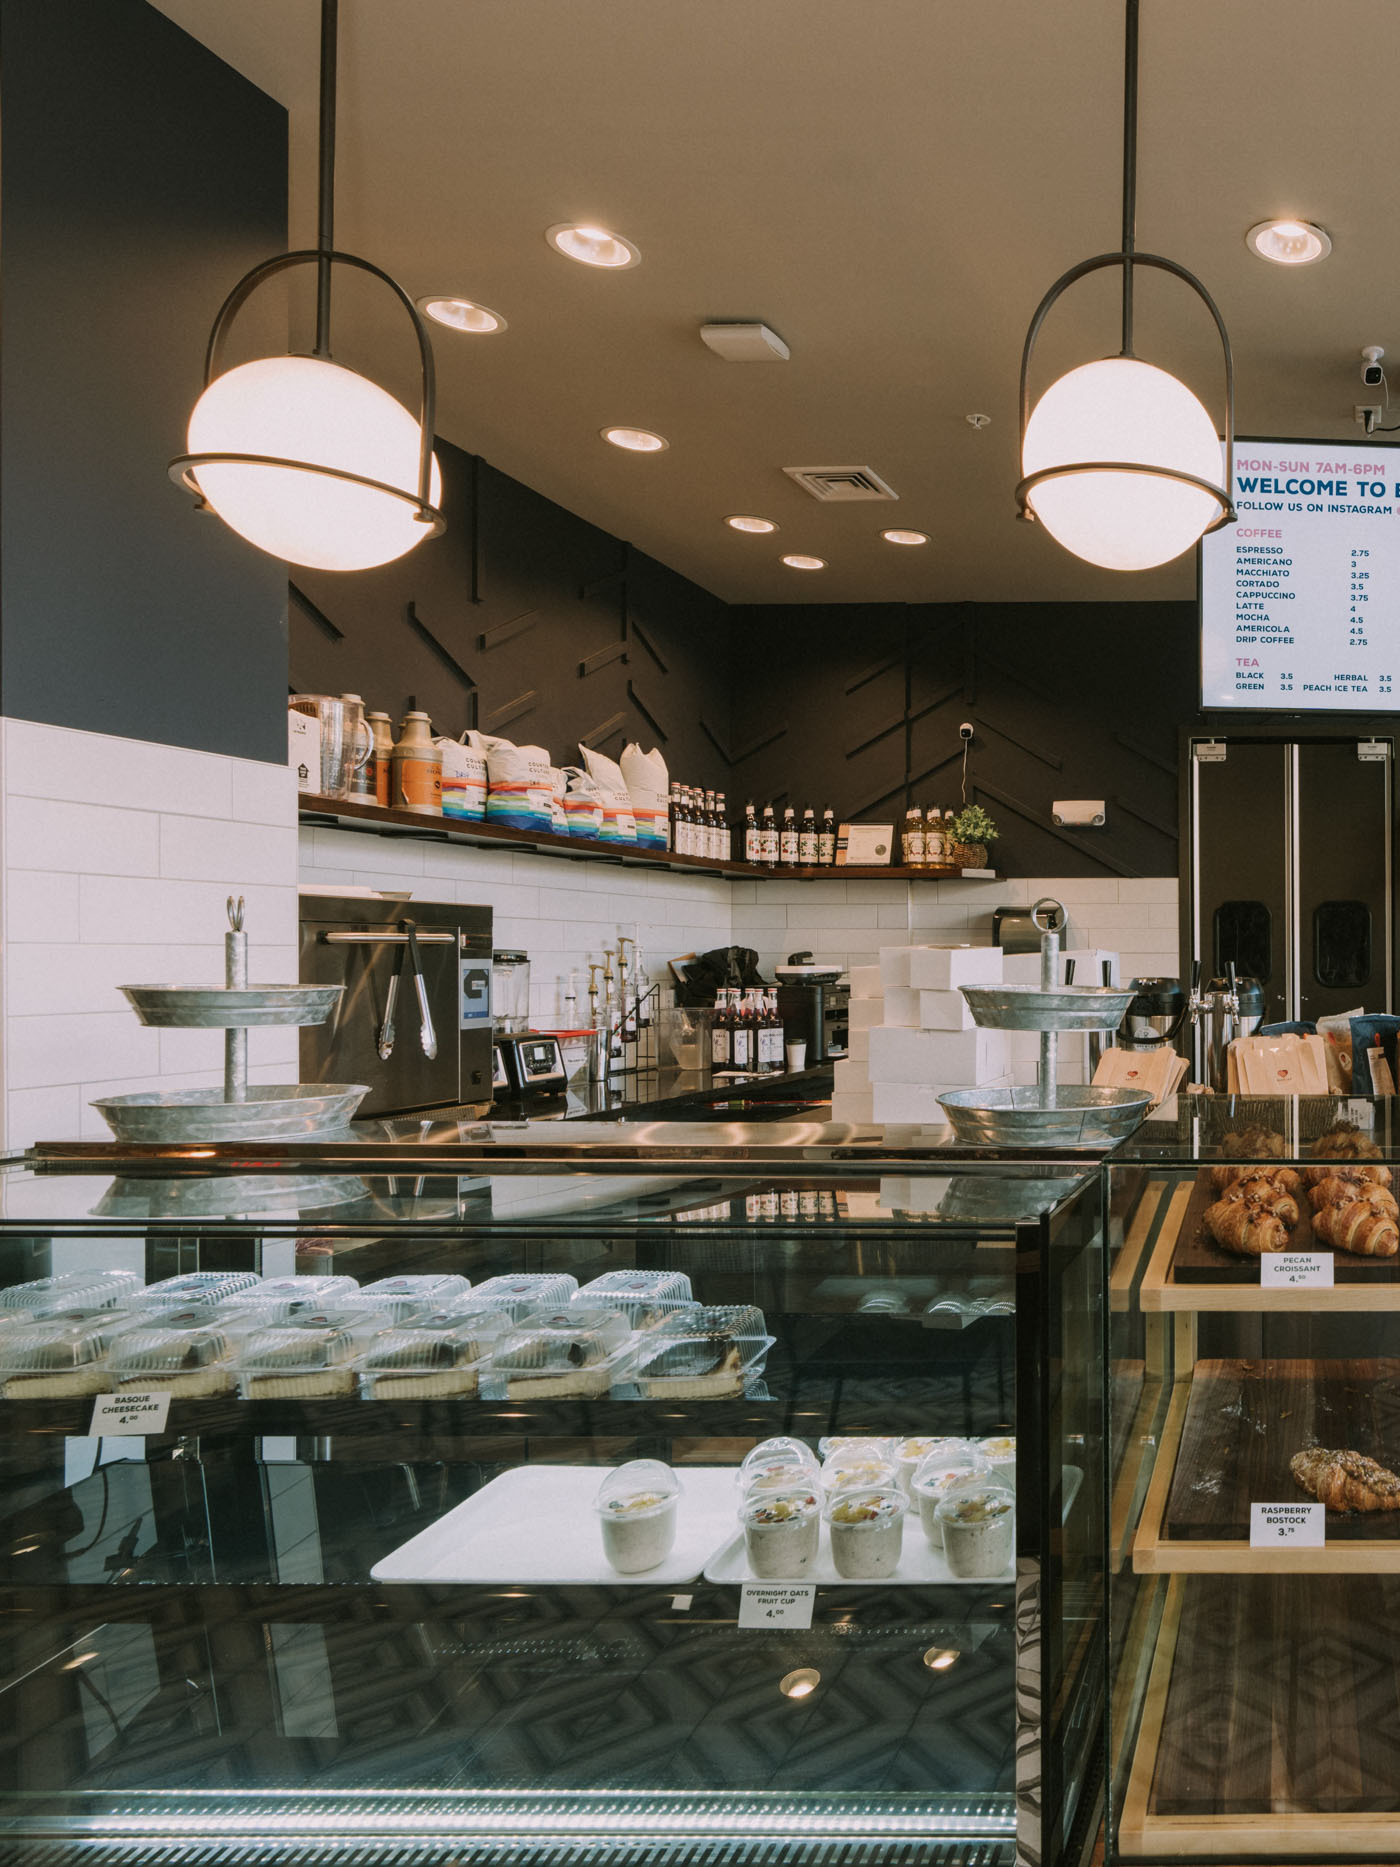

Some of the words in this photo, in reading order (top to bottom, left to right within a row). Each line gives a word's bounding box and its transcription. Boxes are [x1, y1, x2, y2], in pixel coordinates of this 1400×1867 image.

[1237, 459, 1310, 473] MON-SUN
[1316, 462, 1385, 476] 7AM-6PM
[1237, 477, 1347, 496] WELCOME
[1357, 482, 1386, 497] TO
[1236, 501, 1283, 511] FOLLOW
[1288, 503, 1302, 512] US
[1307, 504, 1323, 513] ON
[1328, 504, 1392, 515] INSTAGRAM
[1236, 528, 1282, 538] COFFEE
[1236, 546, 1283, 555] ESPRESSO
[1236, 557, 1292, 566] AMERICANO
[1236, 569, 1289, 577] MACCHIATO
[1236, 580, 1279, 588] CORTADO
[1236, 591, 1295, 600] CAPPUCCINO
[1236, 602, 1264, 610] LATTE
[1236, 625, 1290, 633] AMERICOLA
[1260, 636, 1294, 644] COFFEE
[1236, 658, 1259, 667] TEA
[1334, 674, 1368, 682] HERBAL
[1303, 684, 1331, 692] PEACH
[1351, 685, 1368, 693] TEA
[114, 1395, 150, 1404] BASQUE
[102, 1404, 159, 1414] CHEESECAKE
[119, 1415, 138, 1424] 4.00
[1278, 1528, 1294, 1536] 3.75
[766, 1609, 784, 1618] 4.00
